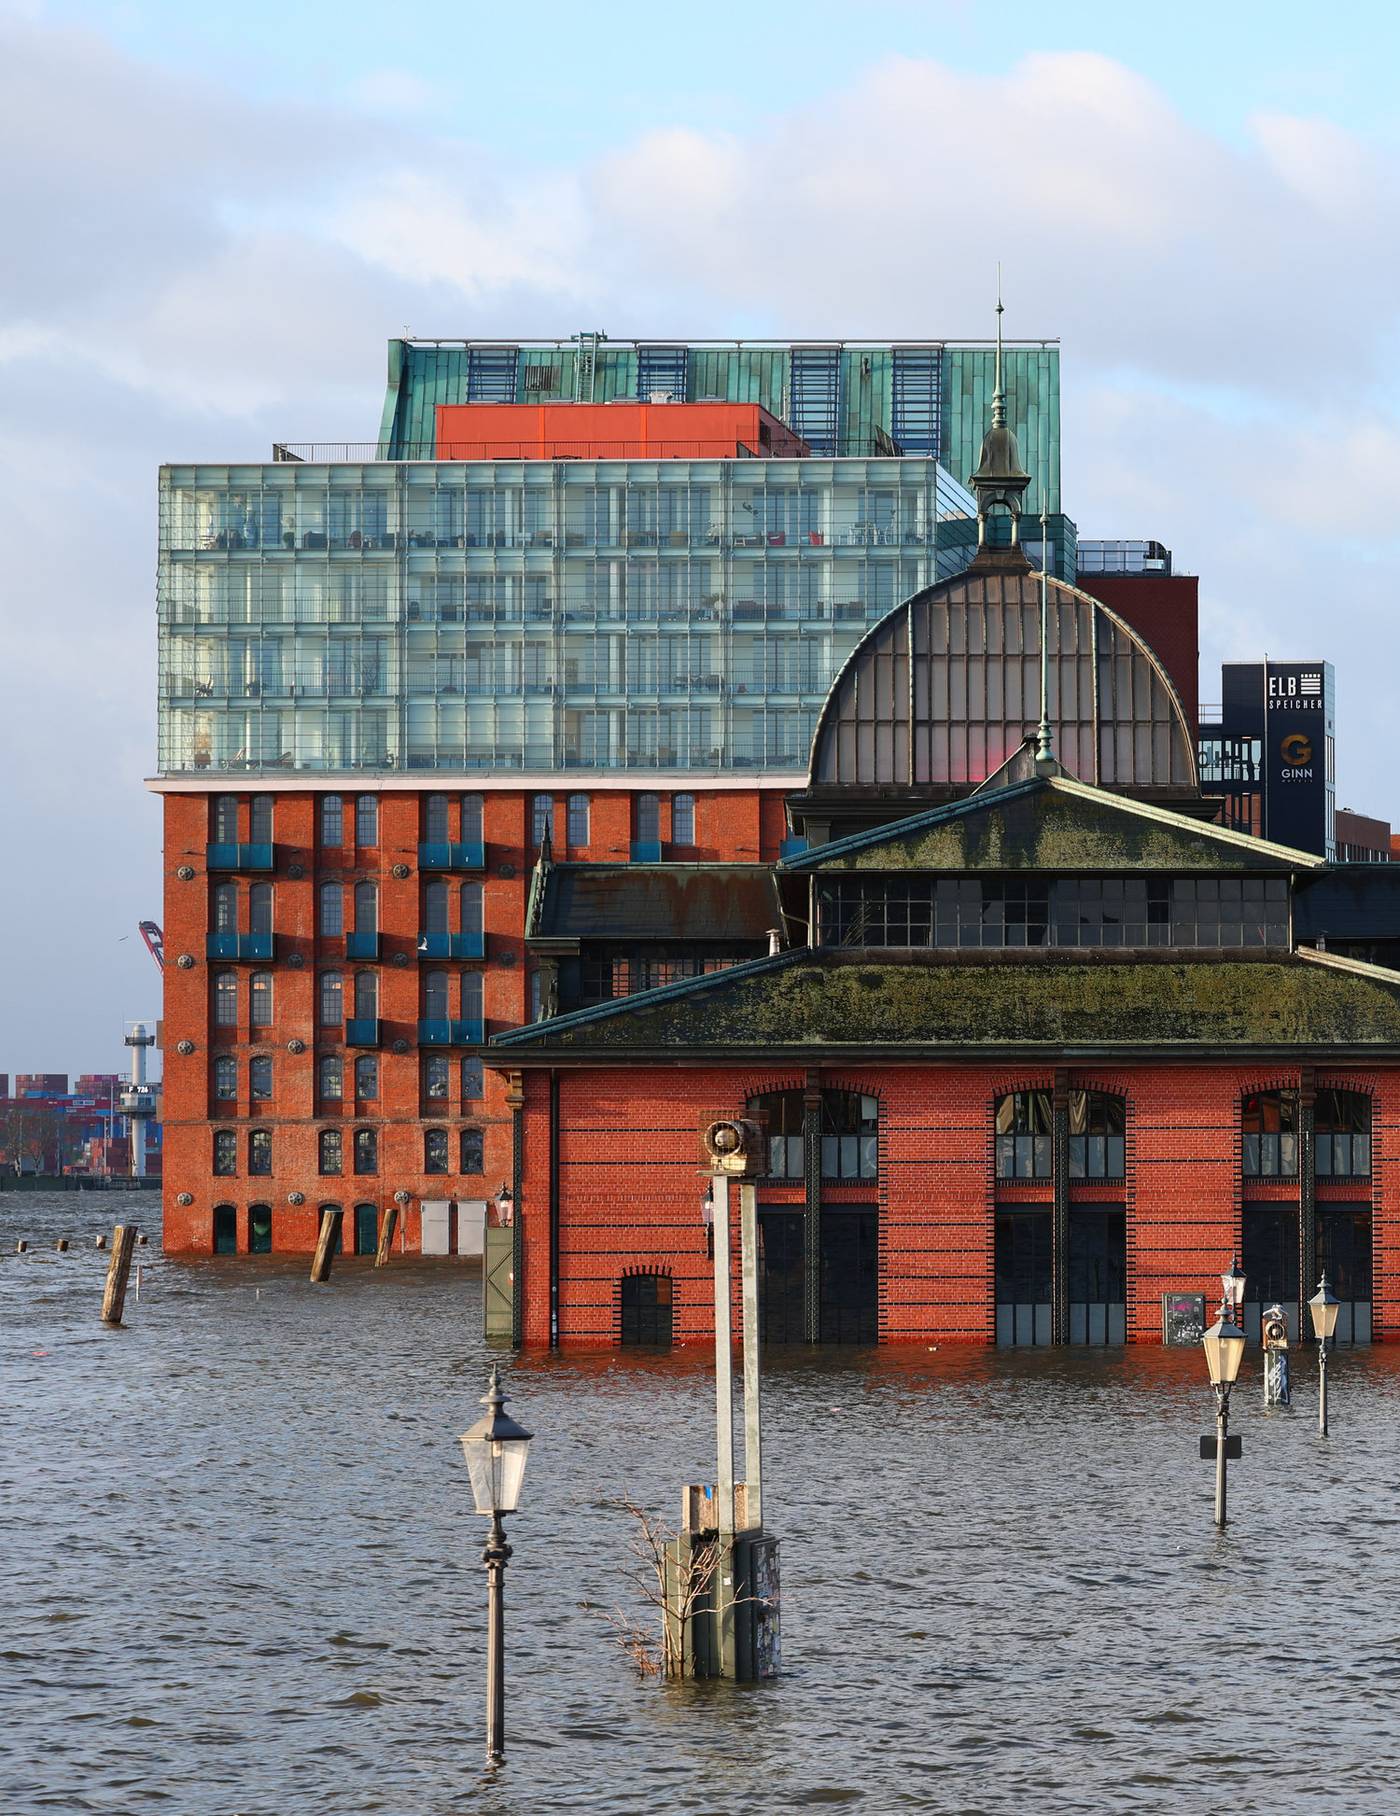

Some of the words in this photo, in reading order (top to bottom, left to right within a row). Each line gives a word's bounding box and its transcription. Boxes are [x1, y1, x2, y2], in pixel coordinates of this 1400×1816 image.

[1269, 677, 1296, 696] ELB
[1269, 700, 1322, 709] SPEICHER
[1281, 734, 1312, 765] G
[1281, 769, 1312, 778] GINN
